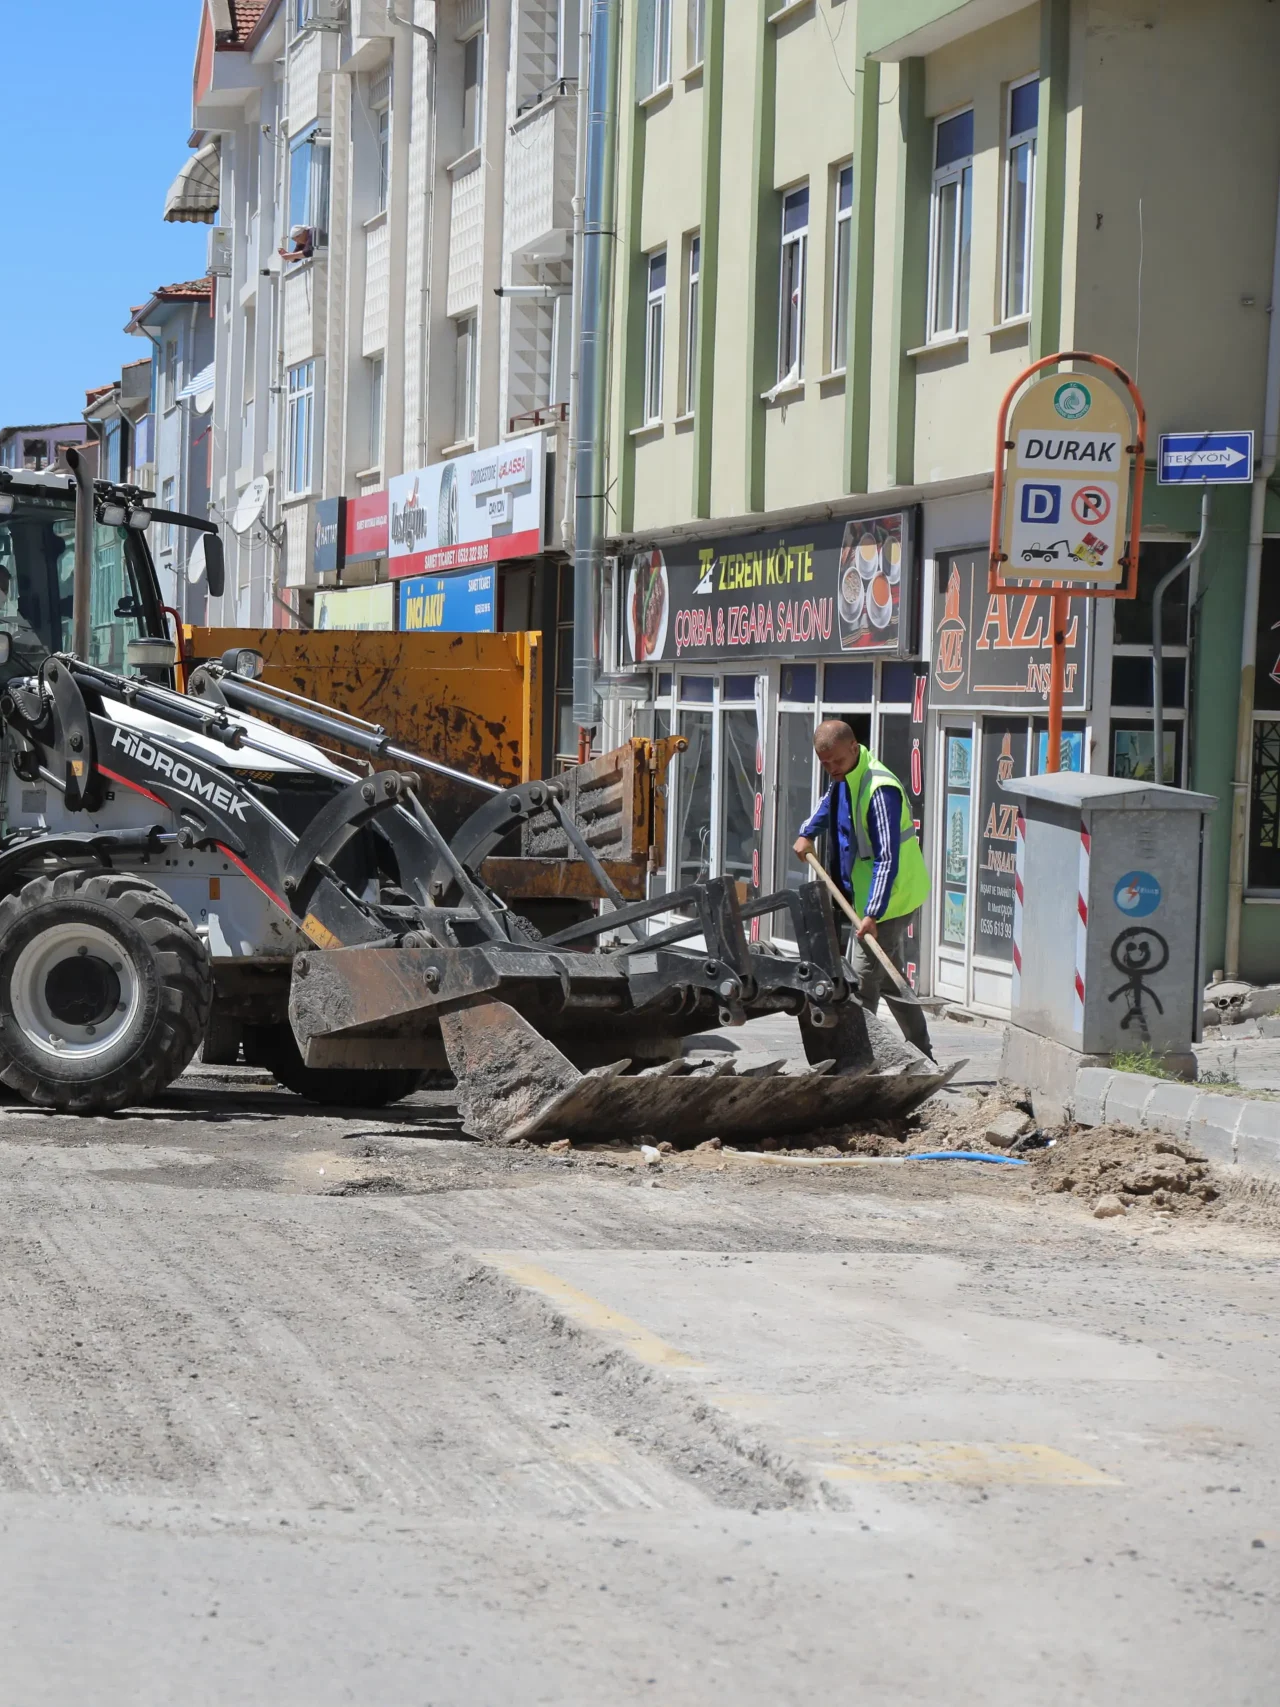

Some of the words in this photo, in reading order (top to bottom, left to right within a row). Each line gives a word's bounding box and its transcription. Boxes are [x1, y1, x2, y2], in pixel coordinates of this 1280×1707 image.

[1025, 438, 1116, 463] DURAK
[1167, 454, 1192, 464] TEK
[1197, 451, 1231, 463] YÖN
[504, 455, 526, 475] LASSA
[17, 497, 68, 509] LPHA
[1027, 488, 1054, 519] D
[424, 555, 439, 570] SAMET
[718, 549, 763, 591] ZEREN
[766, 538, 814, 585] KÖFTE
[406, 584, 424, 630] İNCİ
[424, 581, 445, 627] AKÜ
[675, 606, 713, 656] ÇORBA
[716, 608, 725, 646] &
[727, 601, 775, 645] IZGARA
[776, 597, 833, 642] SALONU
[1025, 656, 1077, 700] İNŞT
[981, 918, 993, 935] 0535
